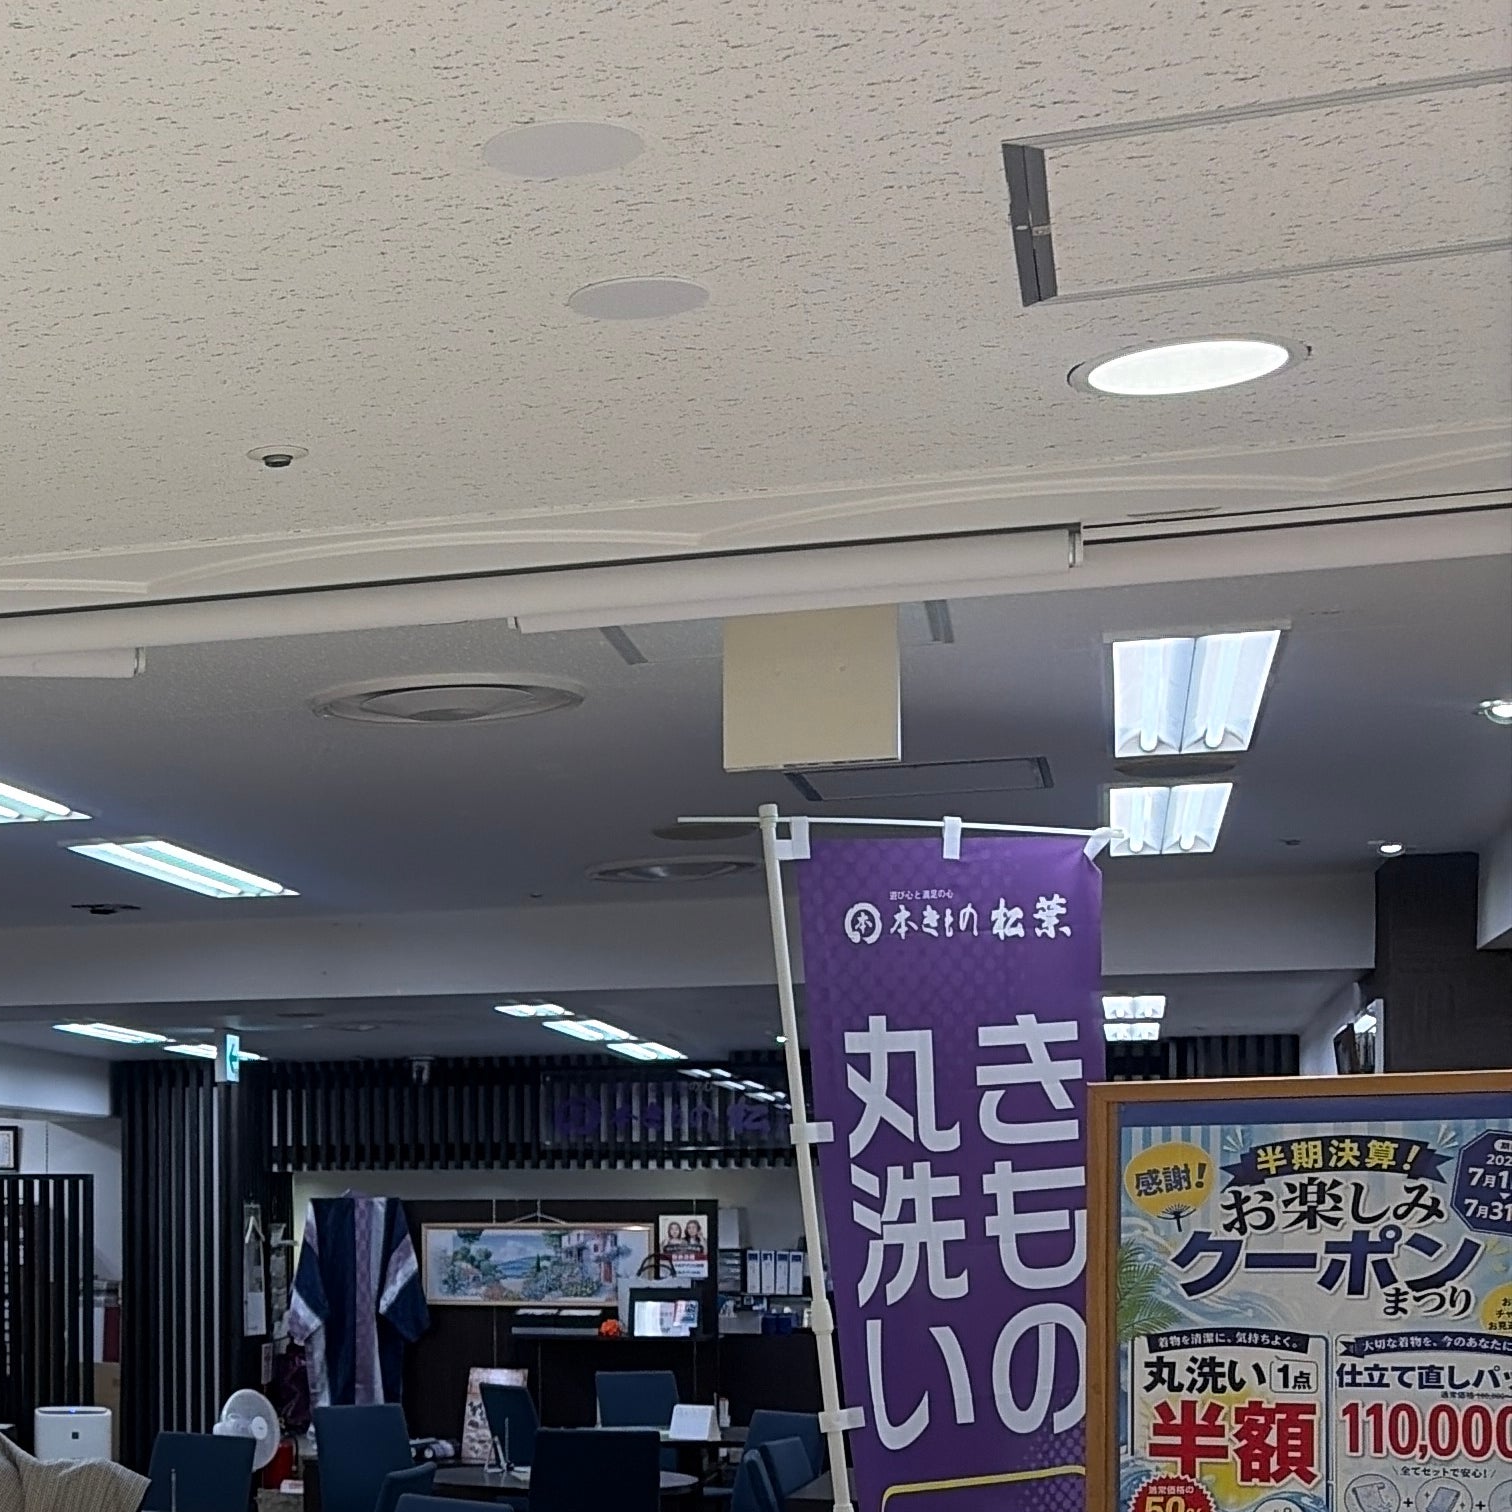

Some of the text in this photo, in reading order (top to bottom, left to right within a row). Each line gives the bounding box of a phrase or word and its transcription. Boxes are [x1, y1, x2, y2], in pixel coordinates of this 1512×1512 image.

[1135, 1163, 1208, 1197] 感謝!
[1256, 1138, 1421, 1175] 半期決算!
[1468, 1167, 1512, 1189] 7月1
[976, 1013, 1086, 1434] きもの
[1220, 1176, 1445, 1235] お楽しみ
[843, 1014, 975, 1451] 丸洗い
[1171, 1224, 1482, 1297] クーポン
[1383, 1285, 1472, 1317] まつり
[1143, 1355, 1312, 1393] 丸洗い 1点
[1148, 1399, 1318, 1484] 半額
